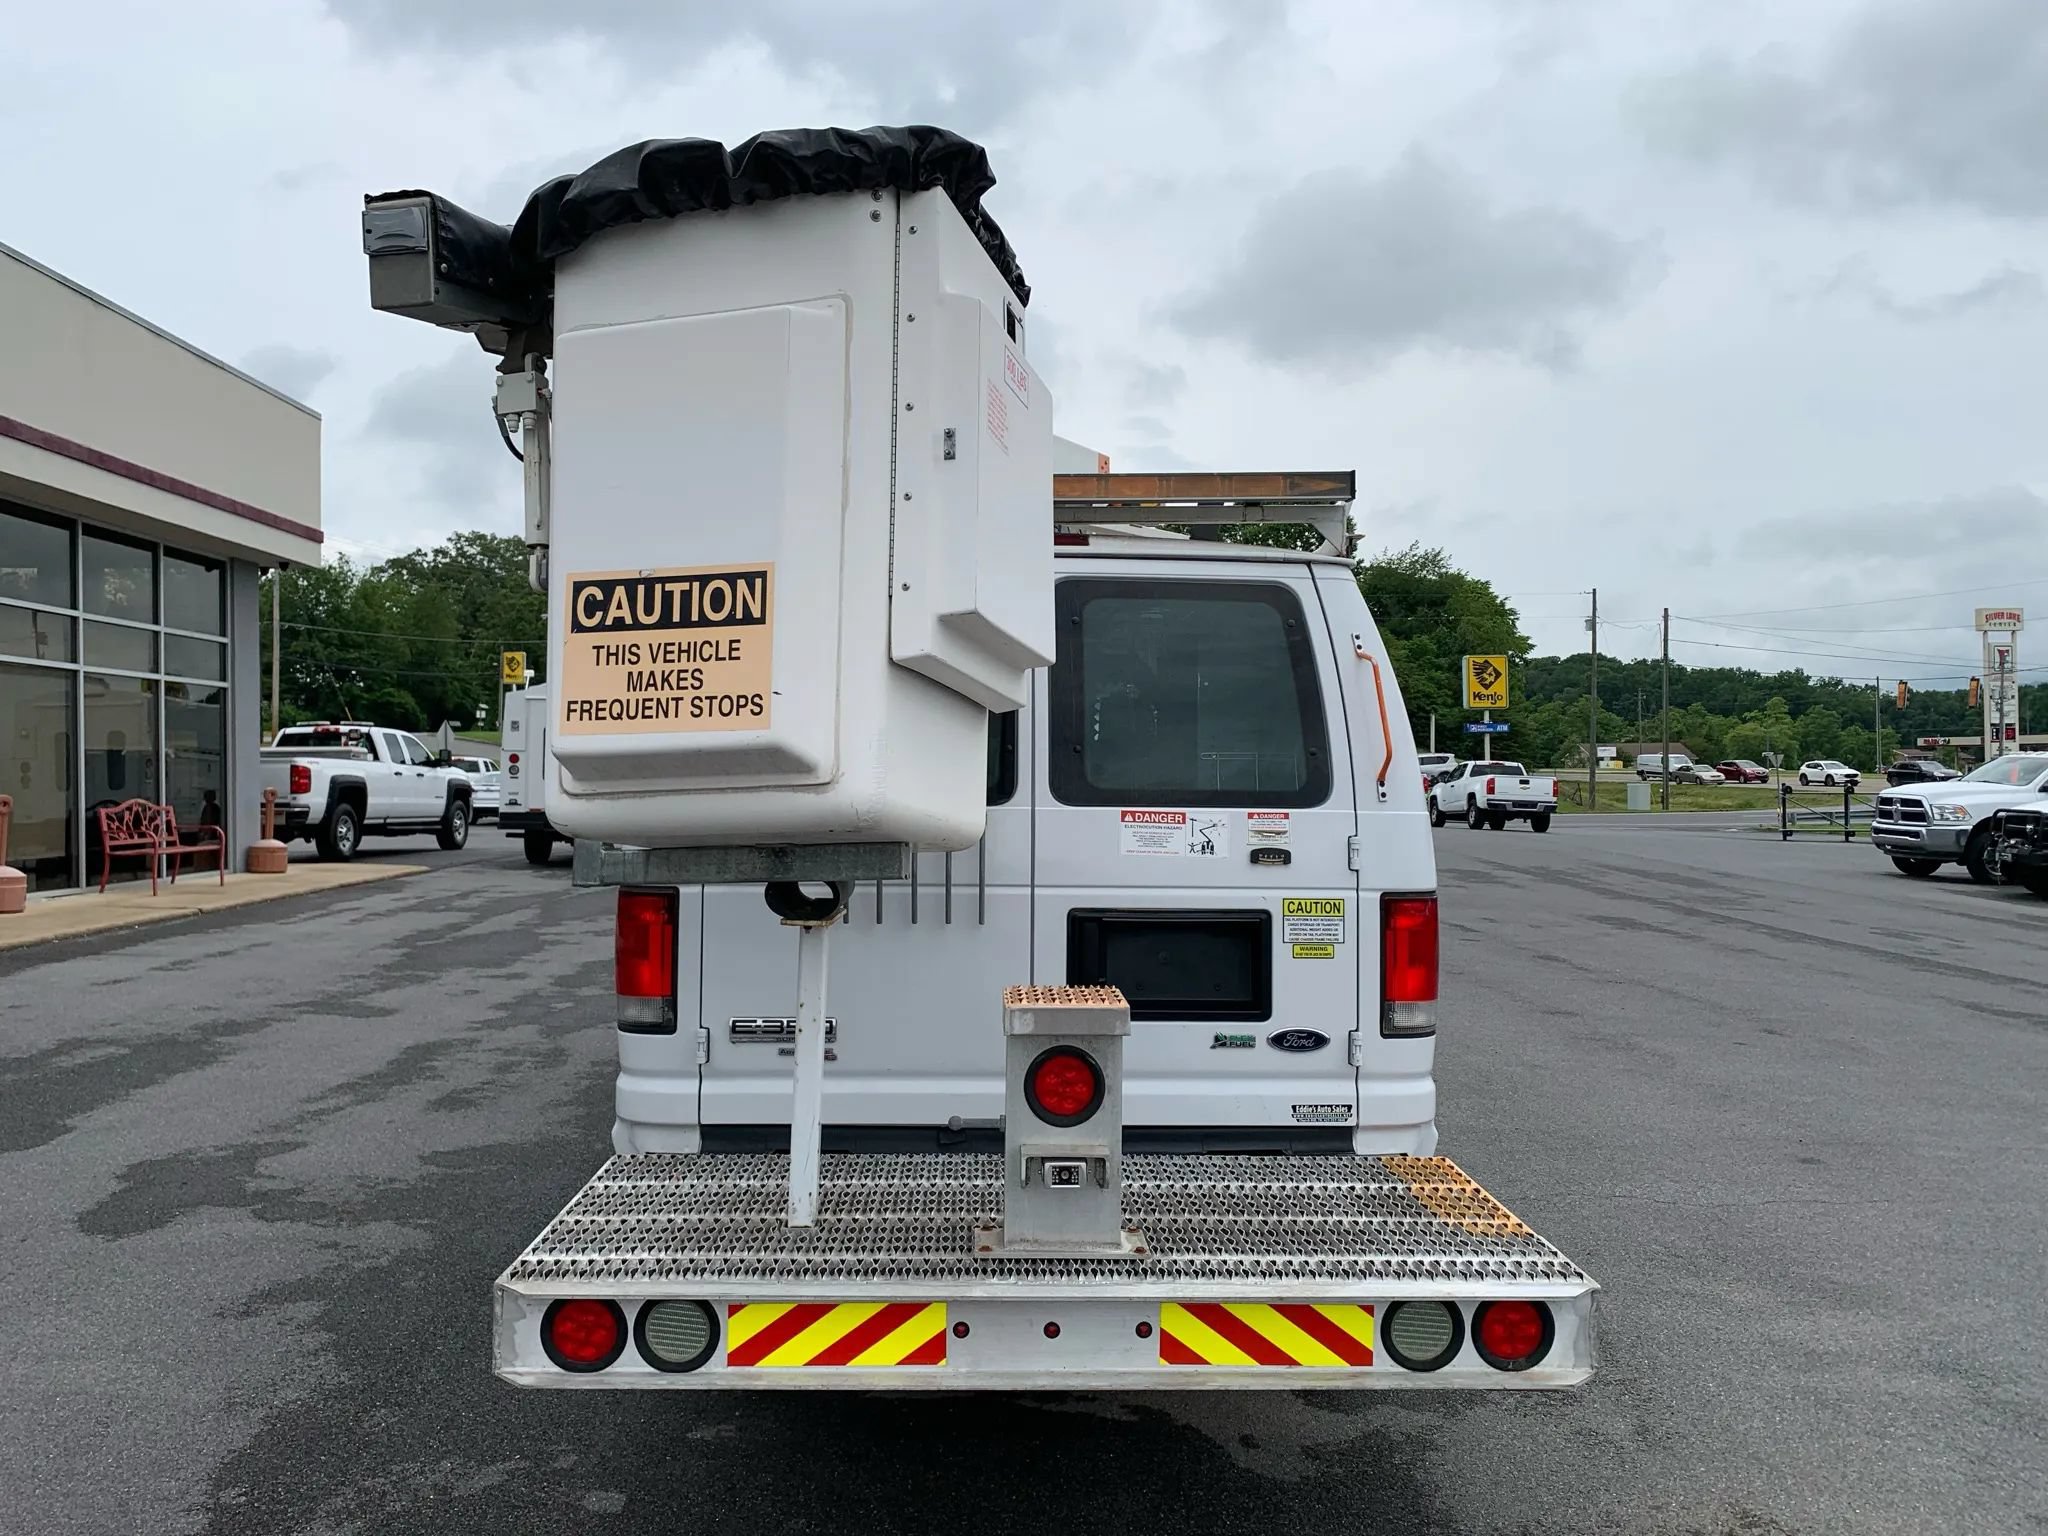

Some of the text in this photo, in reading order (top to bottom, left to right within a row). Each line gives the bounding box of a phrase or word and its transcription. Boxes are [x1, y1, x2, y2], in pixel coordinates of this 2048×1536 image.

[576, 577, 763, 628] CAUTION
[1985, 611, 2021, 623] SILVER LAKE
[592, 639, 742, 667] THIS VEHICLE
[626, 668, 704, 693] MAKES
[1472, 691, 1503, 705] Kenjo
[566, 693, 764, 722] FREQUENT STOPS
[1496, 724, 1508, 732] ATM
[1135, 812, 1183, 824] DANGER
[1287, 901, 1341, 914] CAUTION
[1283, 1032, 1314, 1047] Ford
[1296, 1105, 1348, 1113] Eddie's Auto Sales
